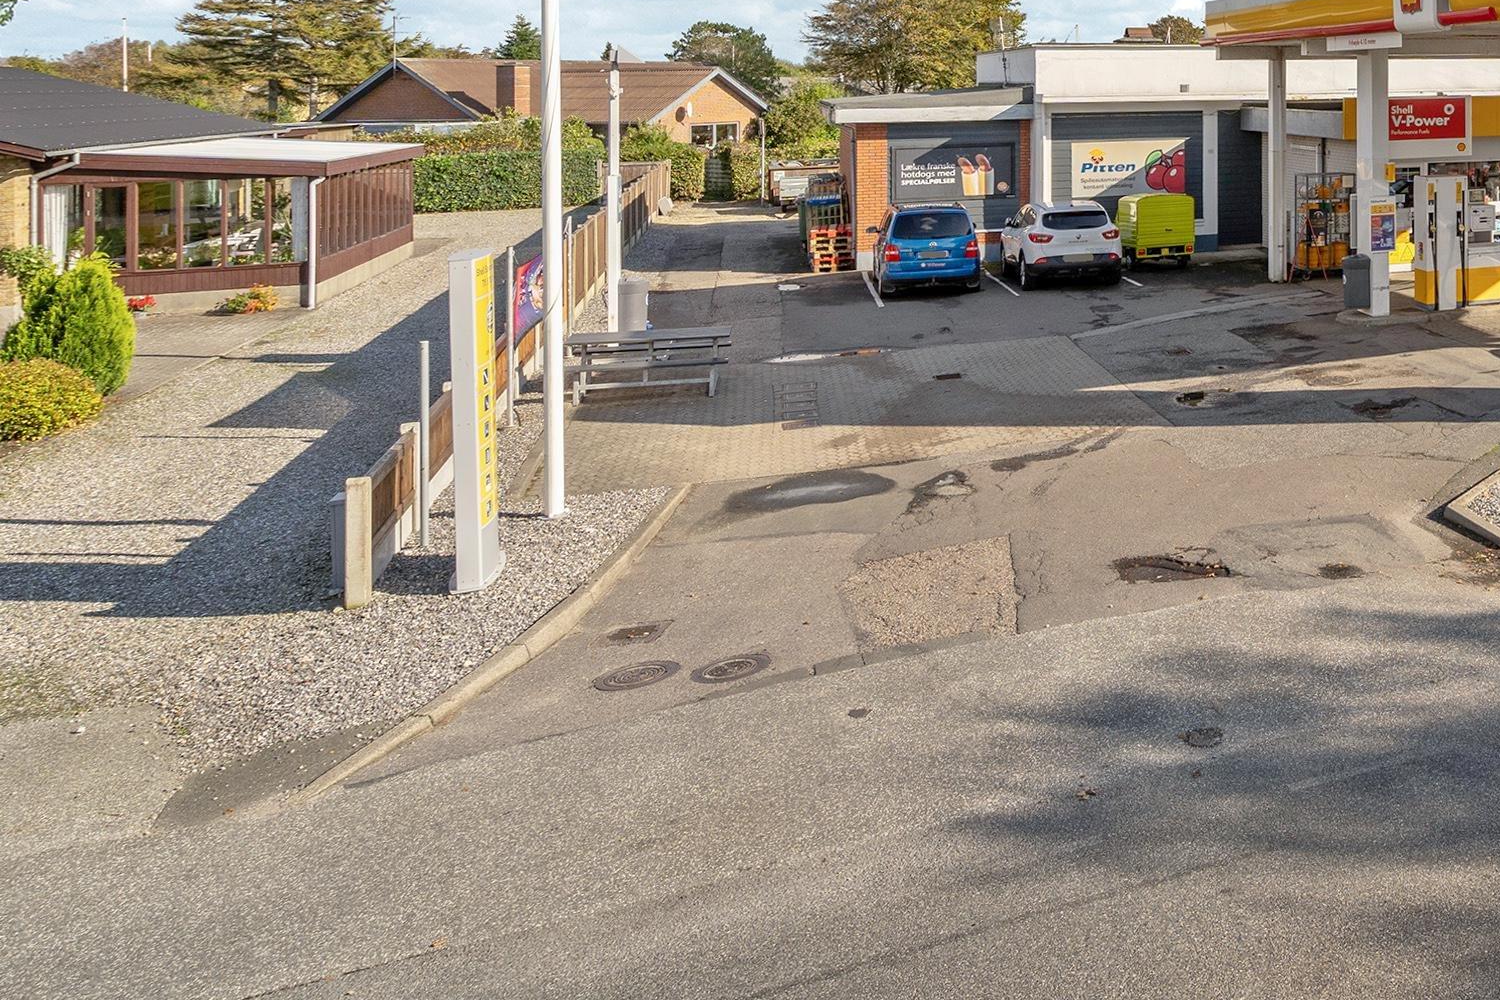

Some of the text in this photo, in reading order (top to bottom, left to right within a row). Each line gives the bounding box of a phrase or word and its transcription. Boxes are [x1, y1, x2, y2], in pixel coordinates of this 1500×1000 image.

[1390, 105, 1413, 115] Shell
[1391, 115, 1451, 127] V-Power
[901, 162, 956, 171] Lækre franske
[901, 169, 956, 179] hotdogs med
[901, 178, 955, 186] SPECIALPØLSER
